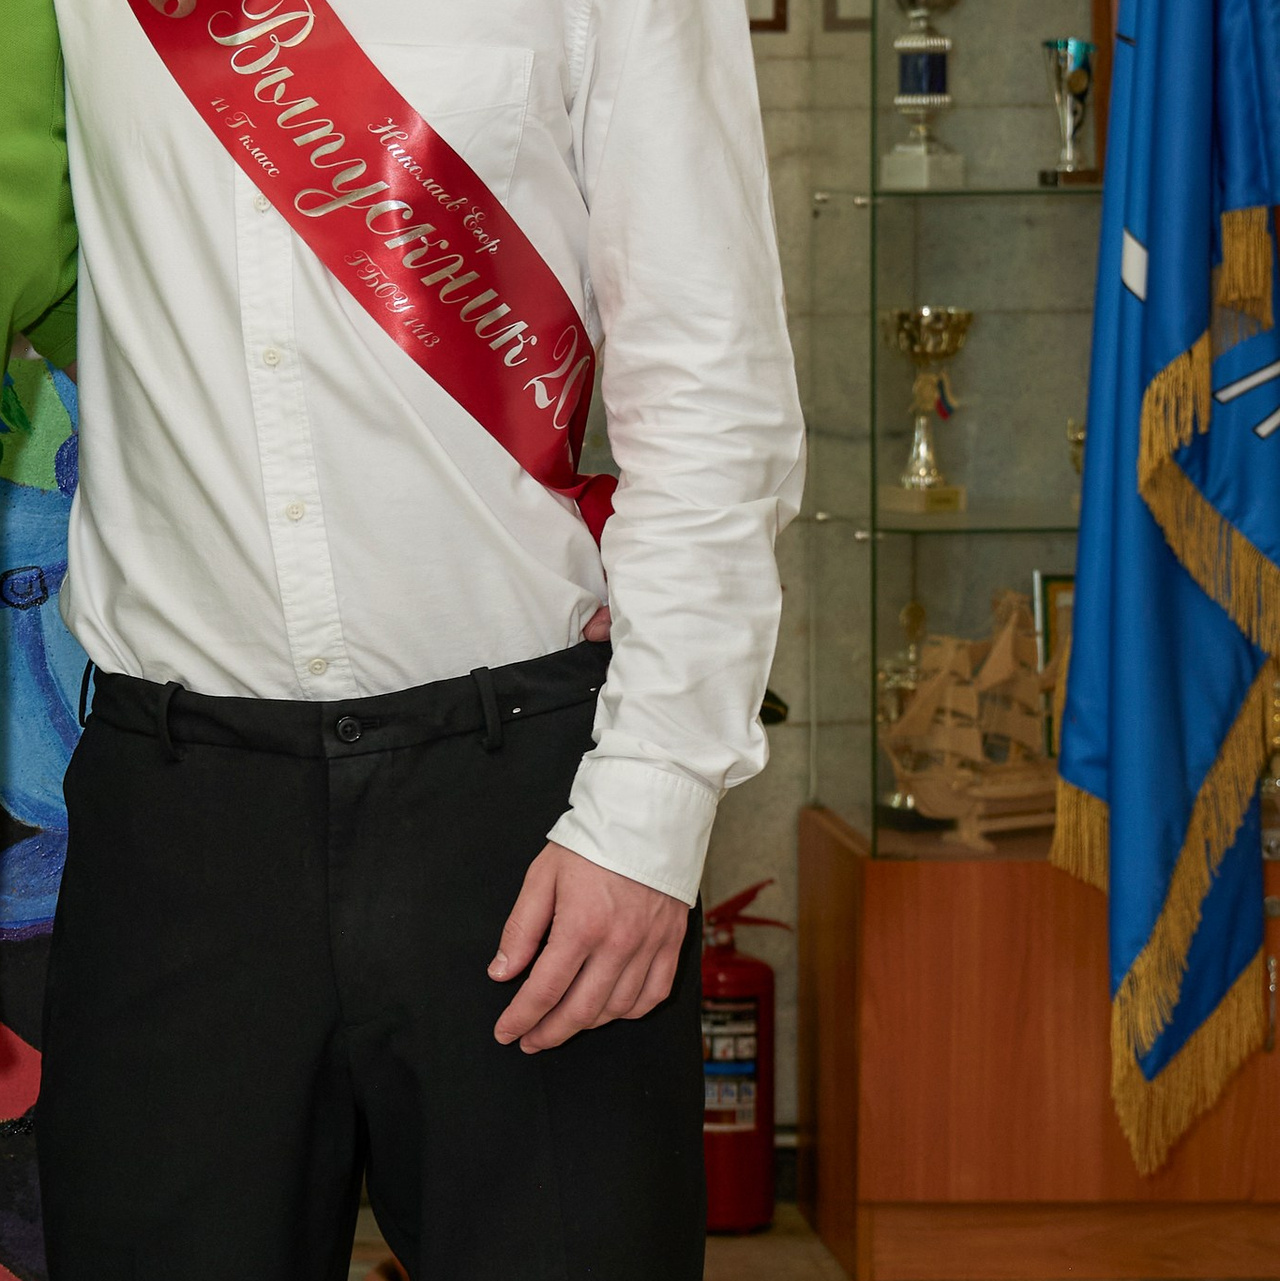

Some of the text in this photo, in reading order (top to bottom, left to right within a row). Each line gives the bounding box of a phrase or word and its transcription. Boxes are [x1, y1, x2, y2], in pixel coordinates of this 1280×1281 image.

[238, 134, 280, 178] класс
[367, 116, 501, 255] Николаев Егор
[343, 249, 416, 313] ГБОУ
